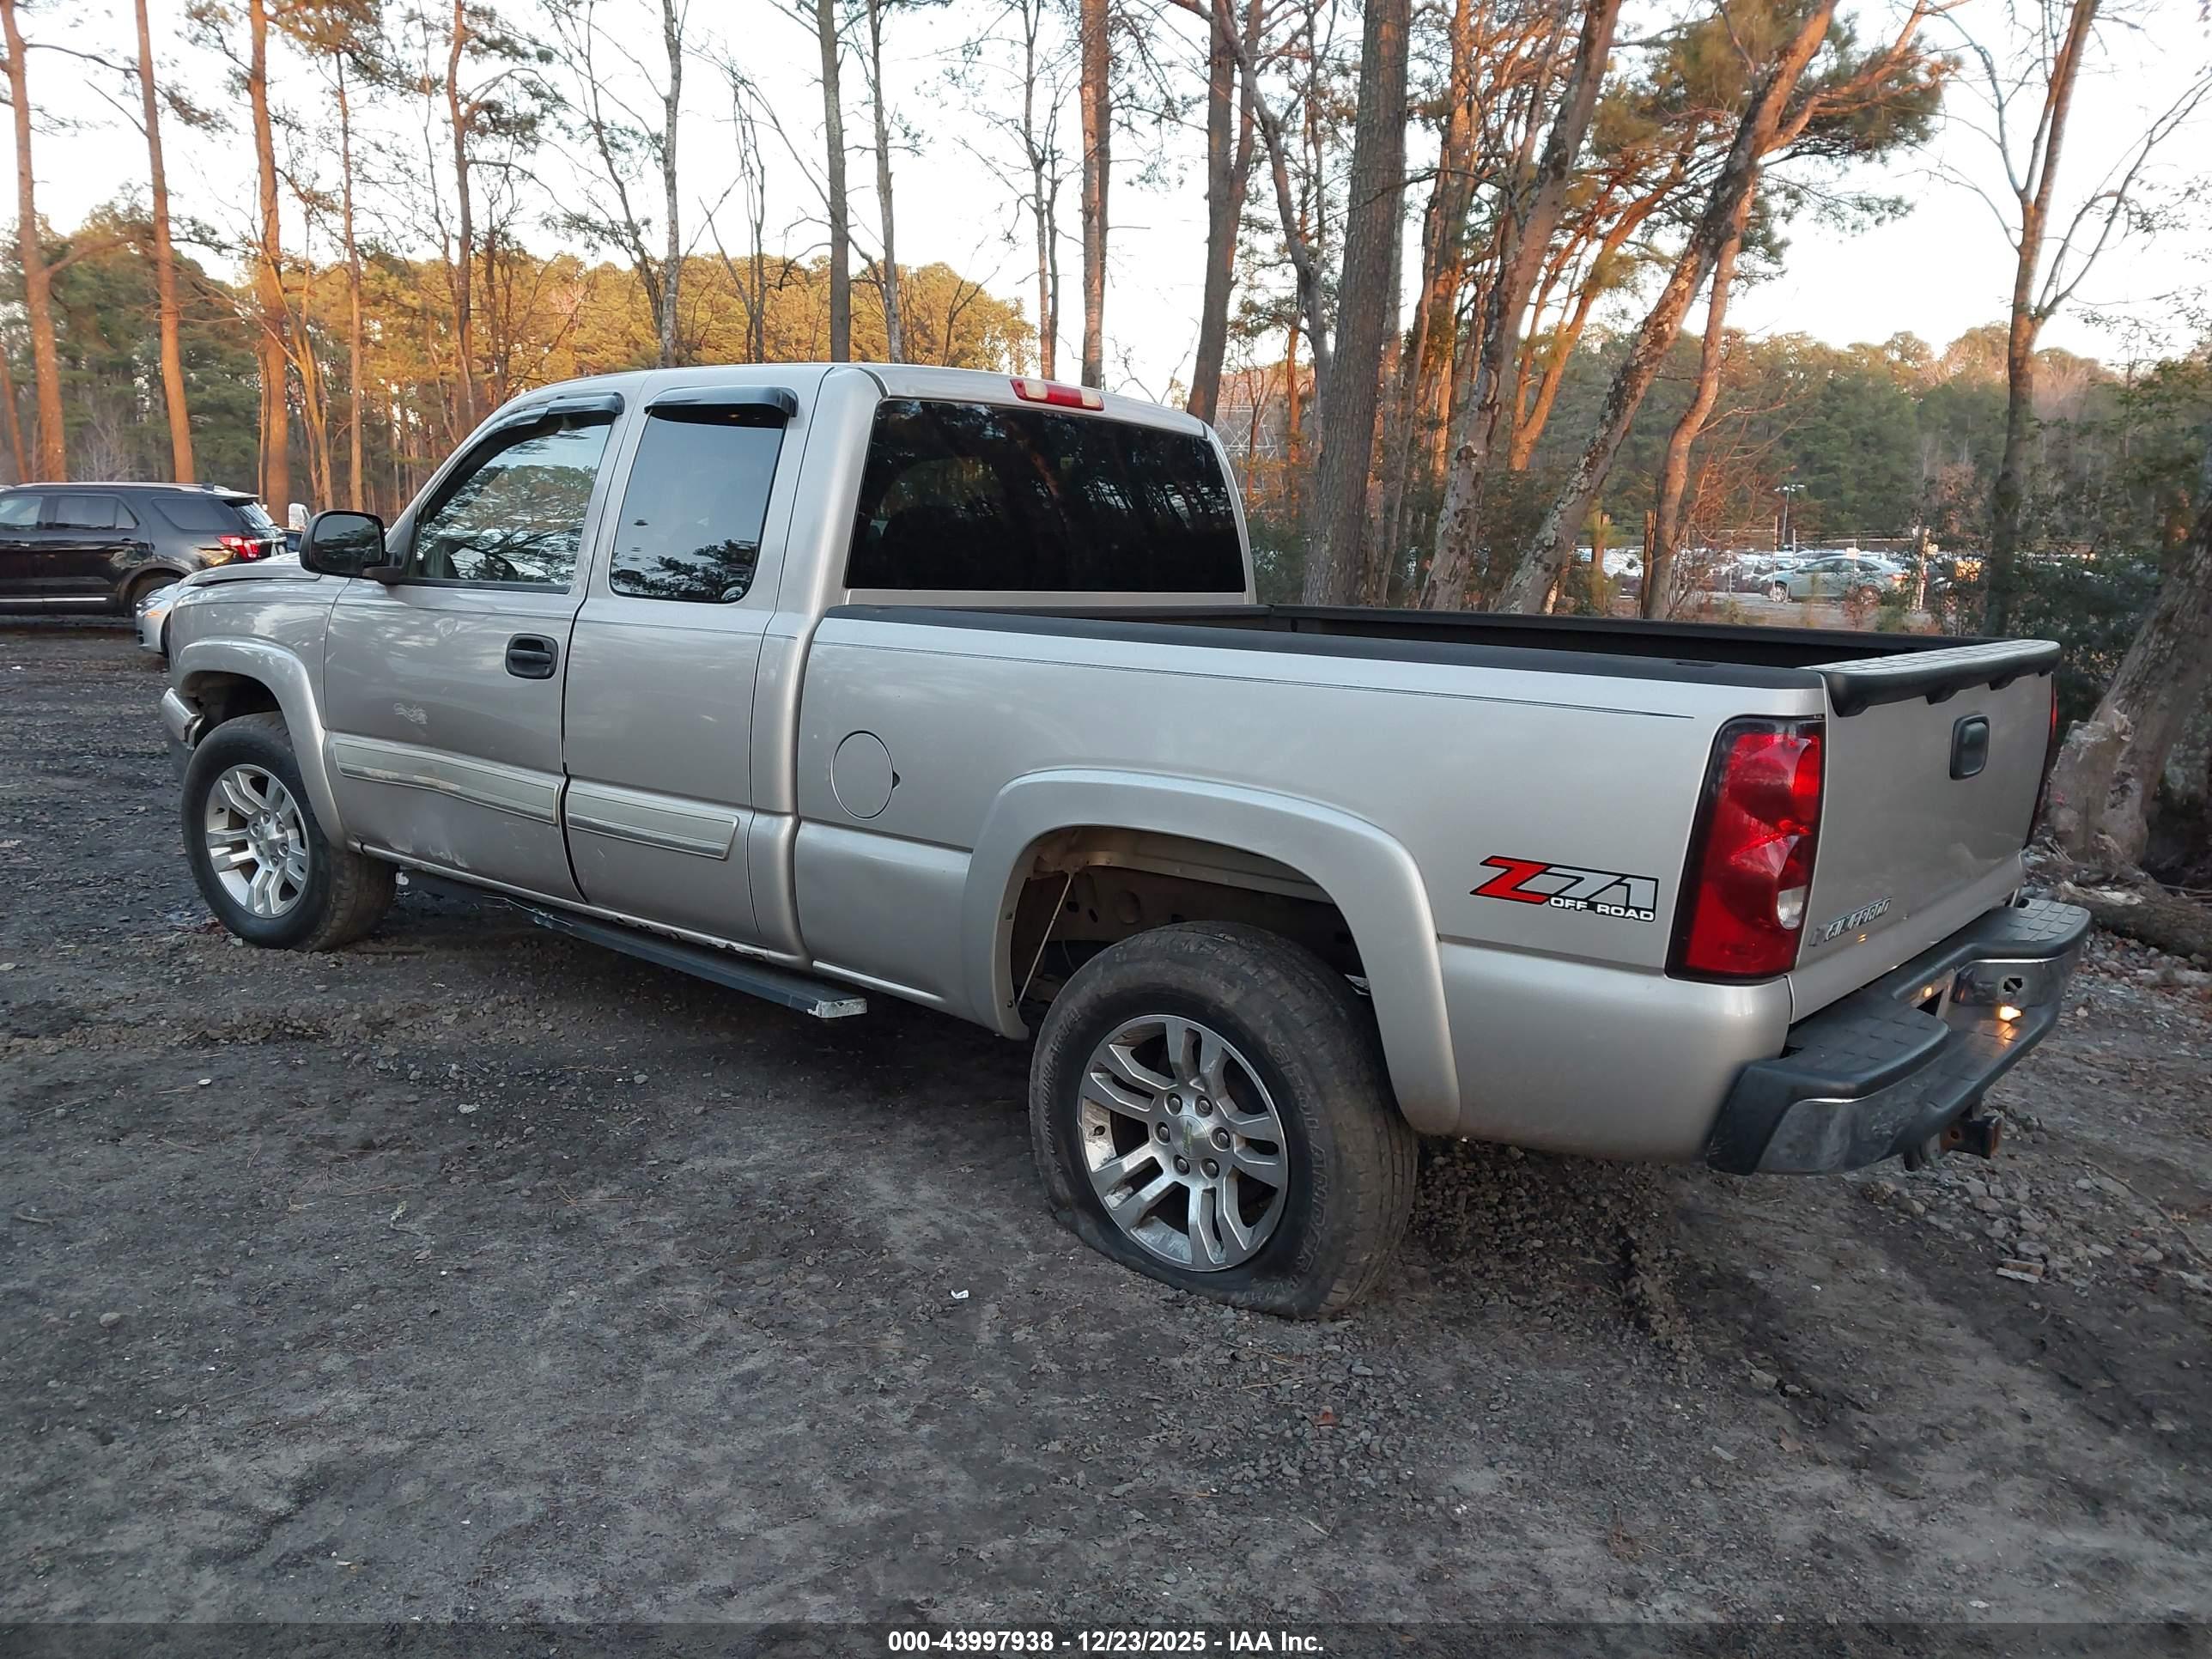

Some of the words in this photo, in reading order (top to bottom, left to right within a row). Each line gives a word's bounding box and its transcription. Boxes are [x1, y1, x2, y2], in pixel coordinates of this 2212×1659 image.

[1469, 855, 1659, 911] Z71
[1549, 896, 1589, 911] OFF
[1595, 902, 1656, 922] ROAD
